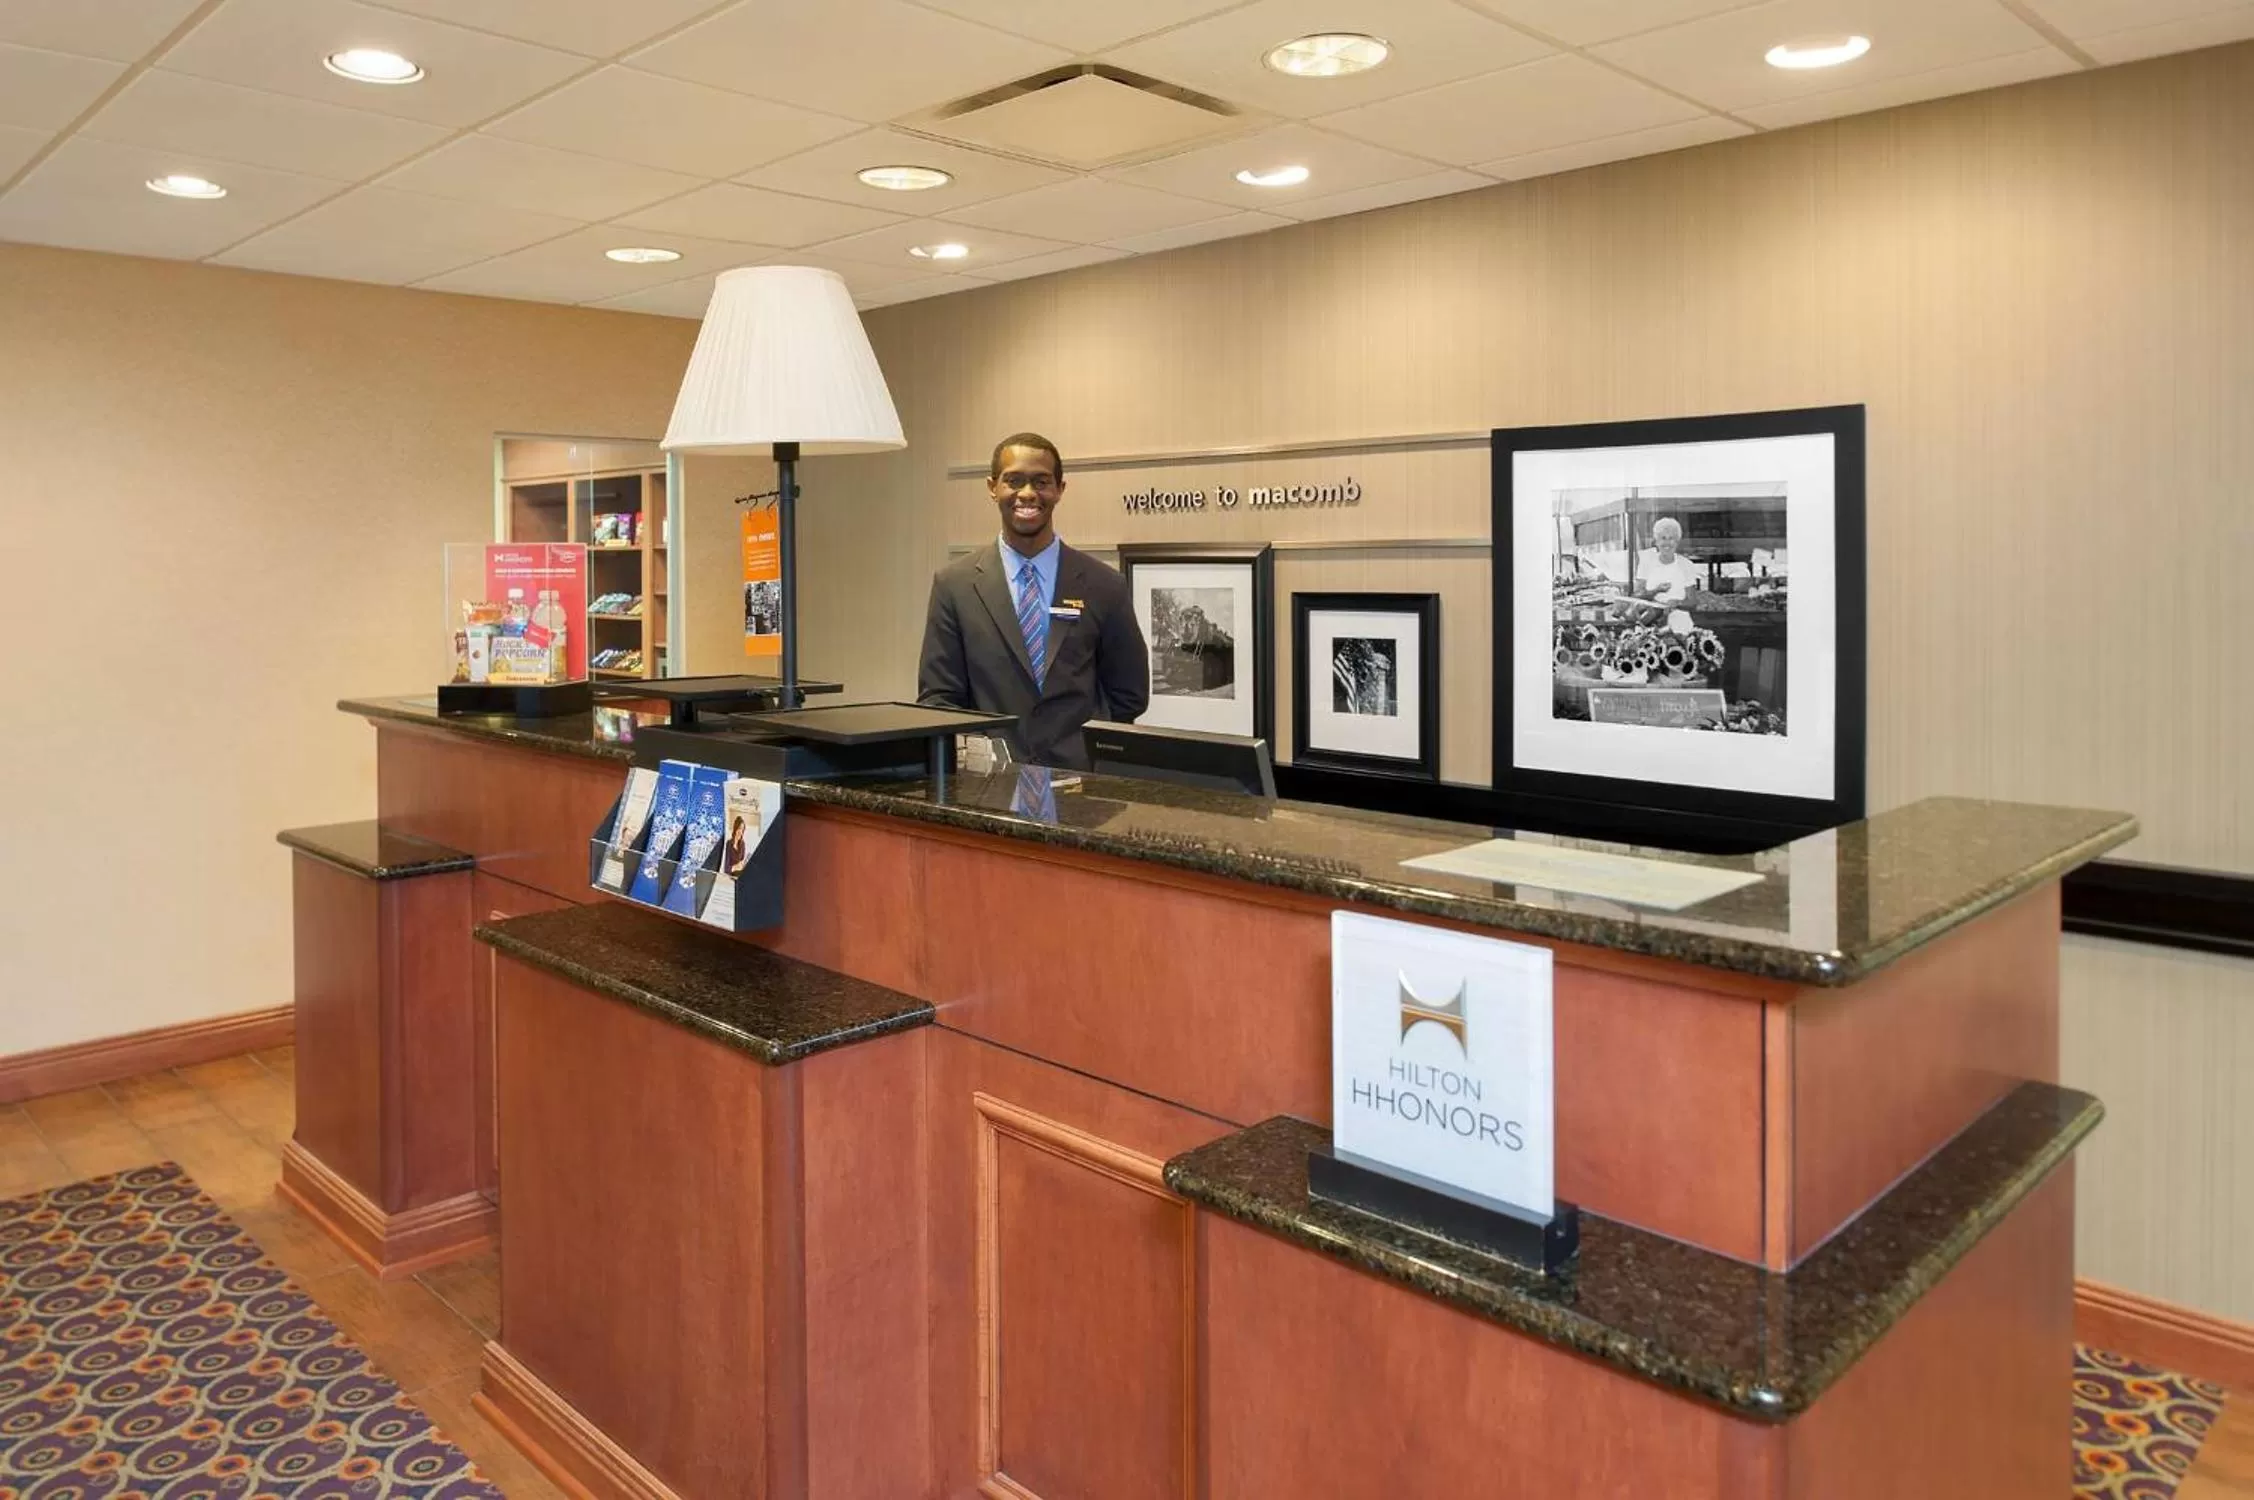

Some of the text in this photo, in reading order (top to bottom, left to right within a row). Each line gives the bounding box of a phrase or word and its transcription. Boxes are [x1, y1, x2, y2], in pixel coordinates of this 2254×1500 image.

[1124, 477, 1361, 511] welcome to macomb
[496, 648, 546, 658] POPCORN
[1388, 1057, 1482, 1102] HILTON
[1352, 1078, 1525, 1152] HHONORS
